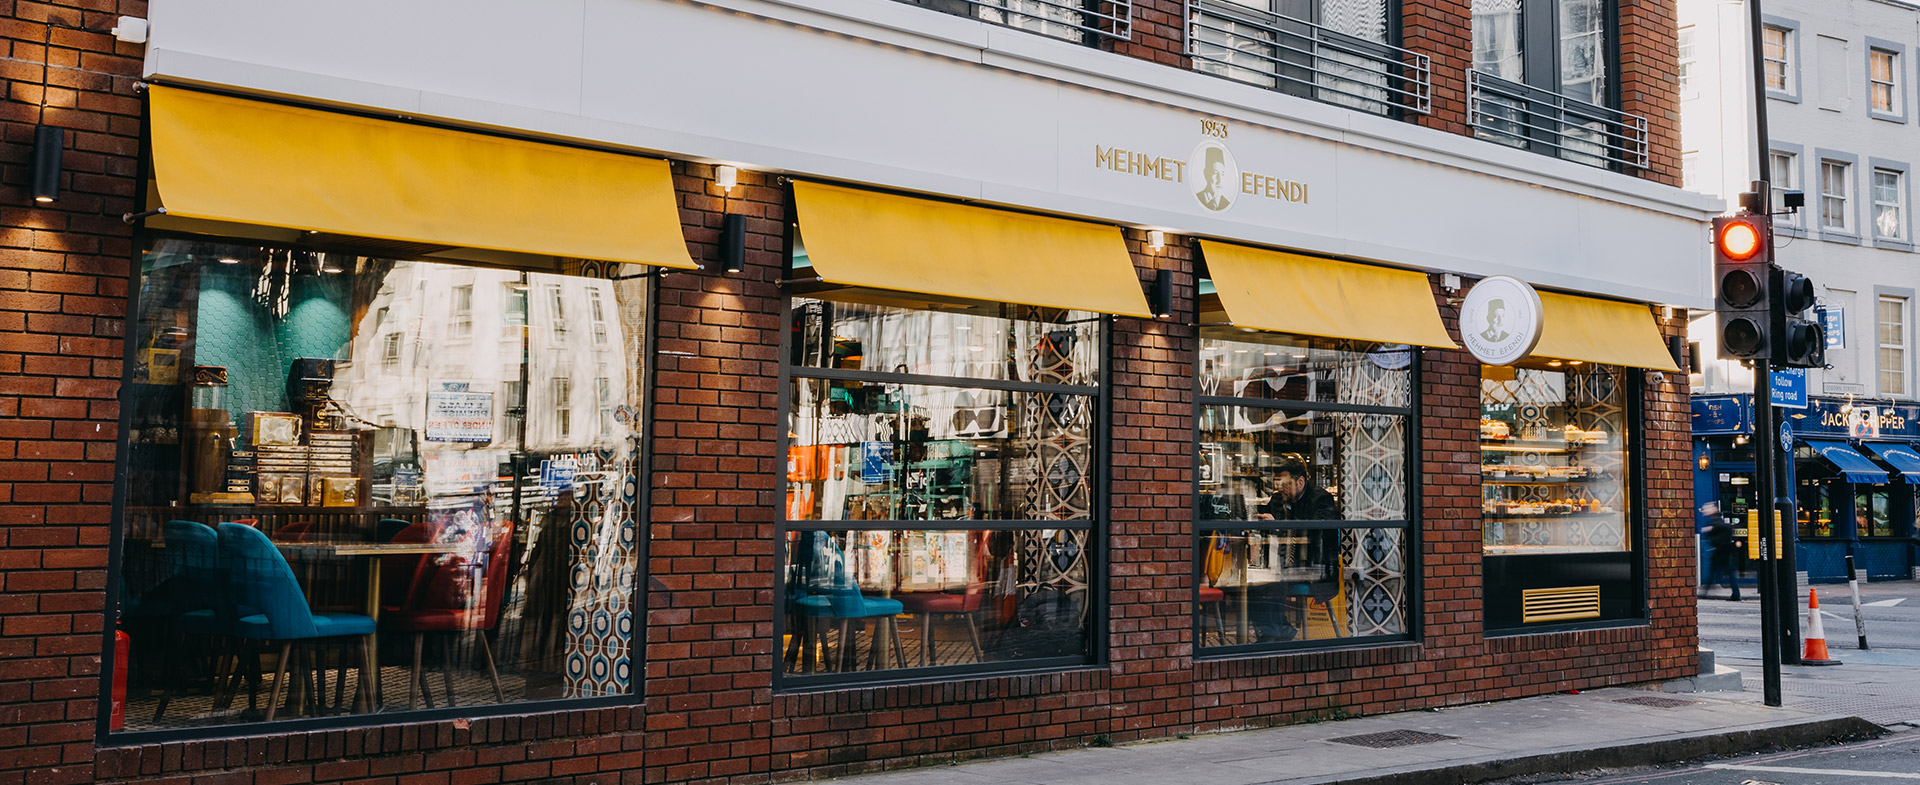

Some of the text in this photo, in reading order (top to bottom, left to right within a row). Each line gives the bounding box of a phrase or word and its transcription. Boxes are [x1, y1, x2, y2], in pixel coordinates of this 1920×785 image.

[1200, 118, 1228, 139] 1953
[1095, 144, 1309, 204] MEHMET EFENDI
[1467, 331, 1525, 357] MEHMET EFENDI
[1775, 375, 1793, 387] follow
[1771, 388, 1798, 401] Ring road
[1821, 410, 1850, 427] JACK
